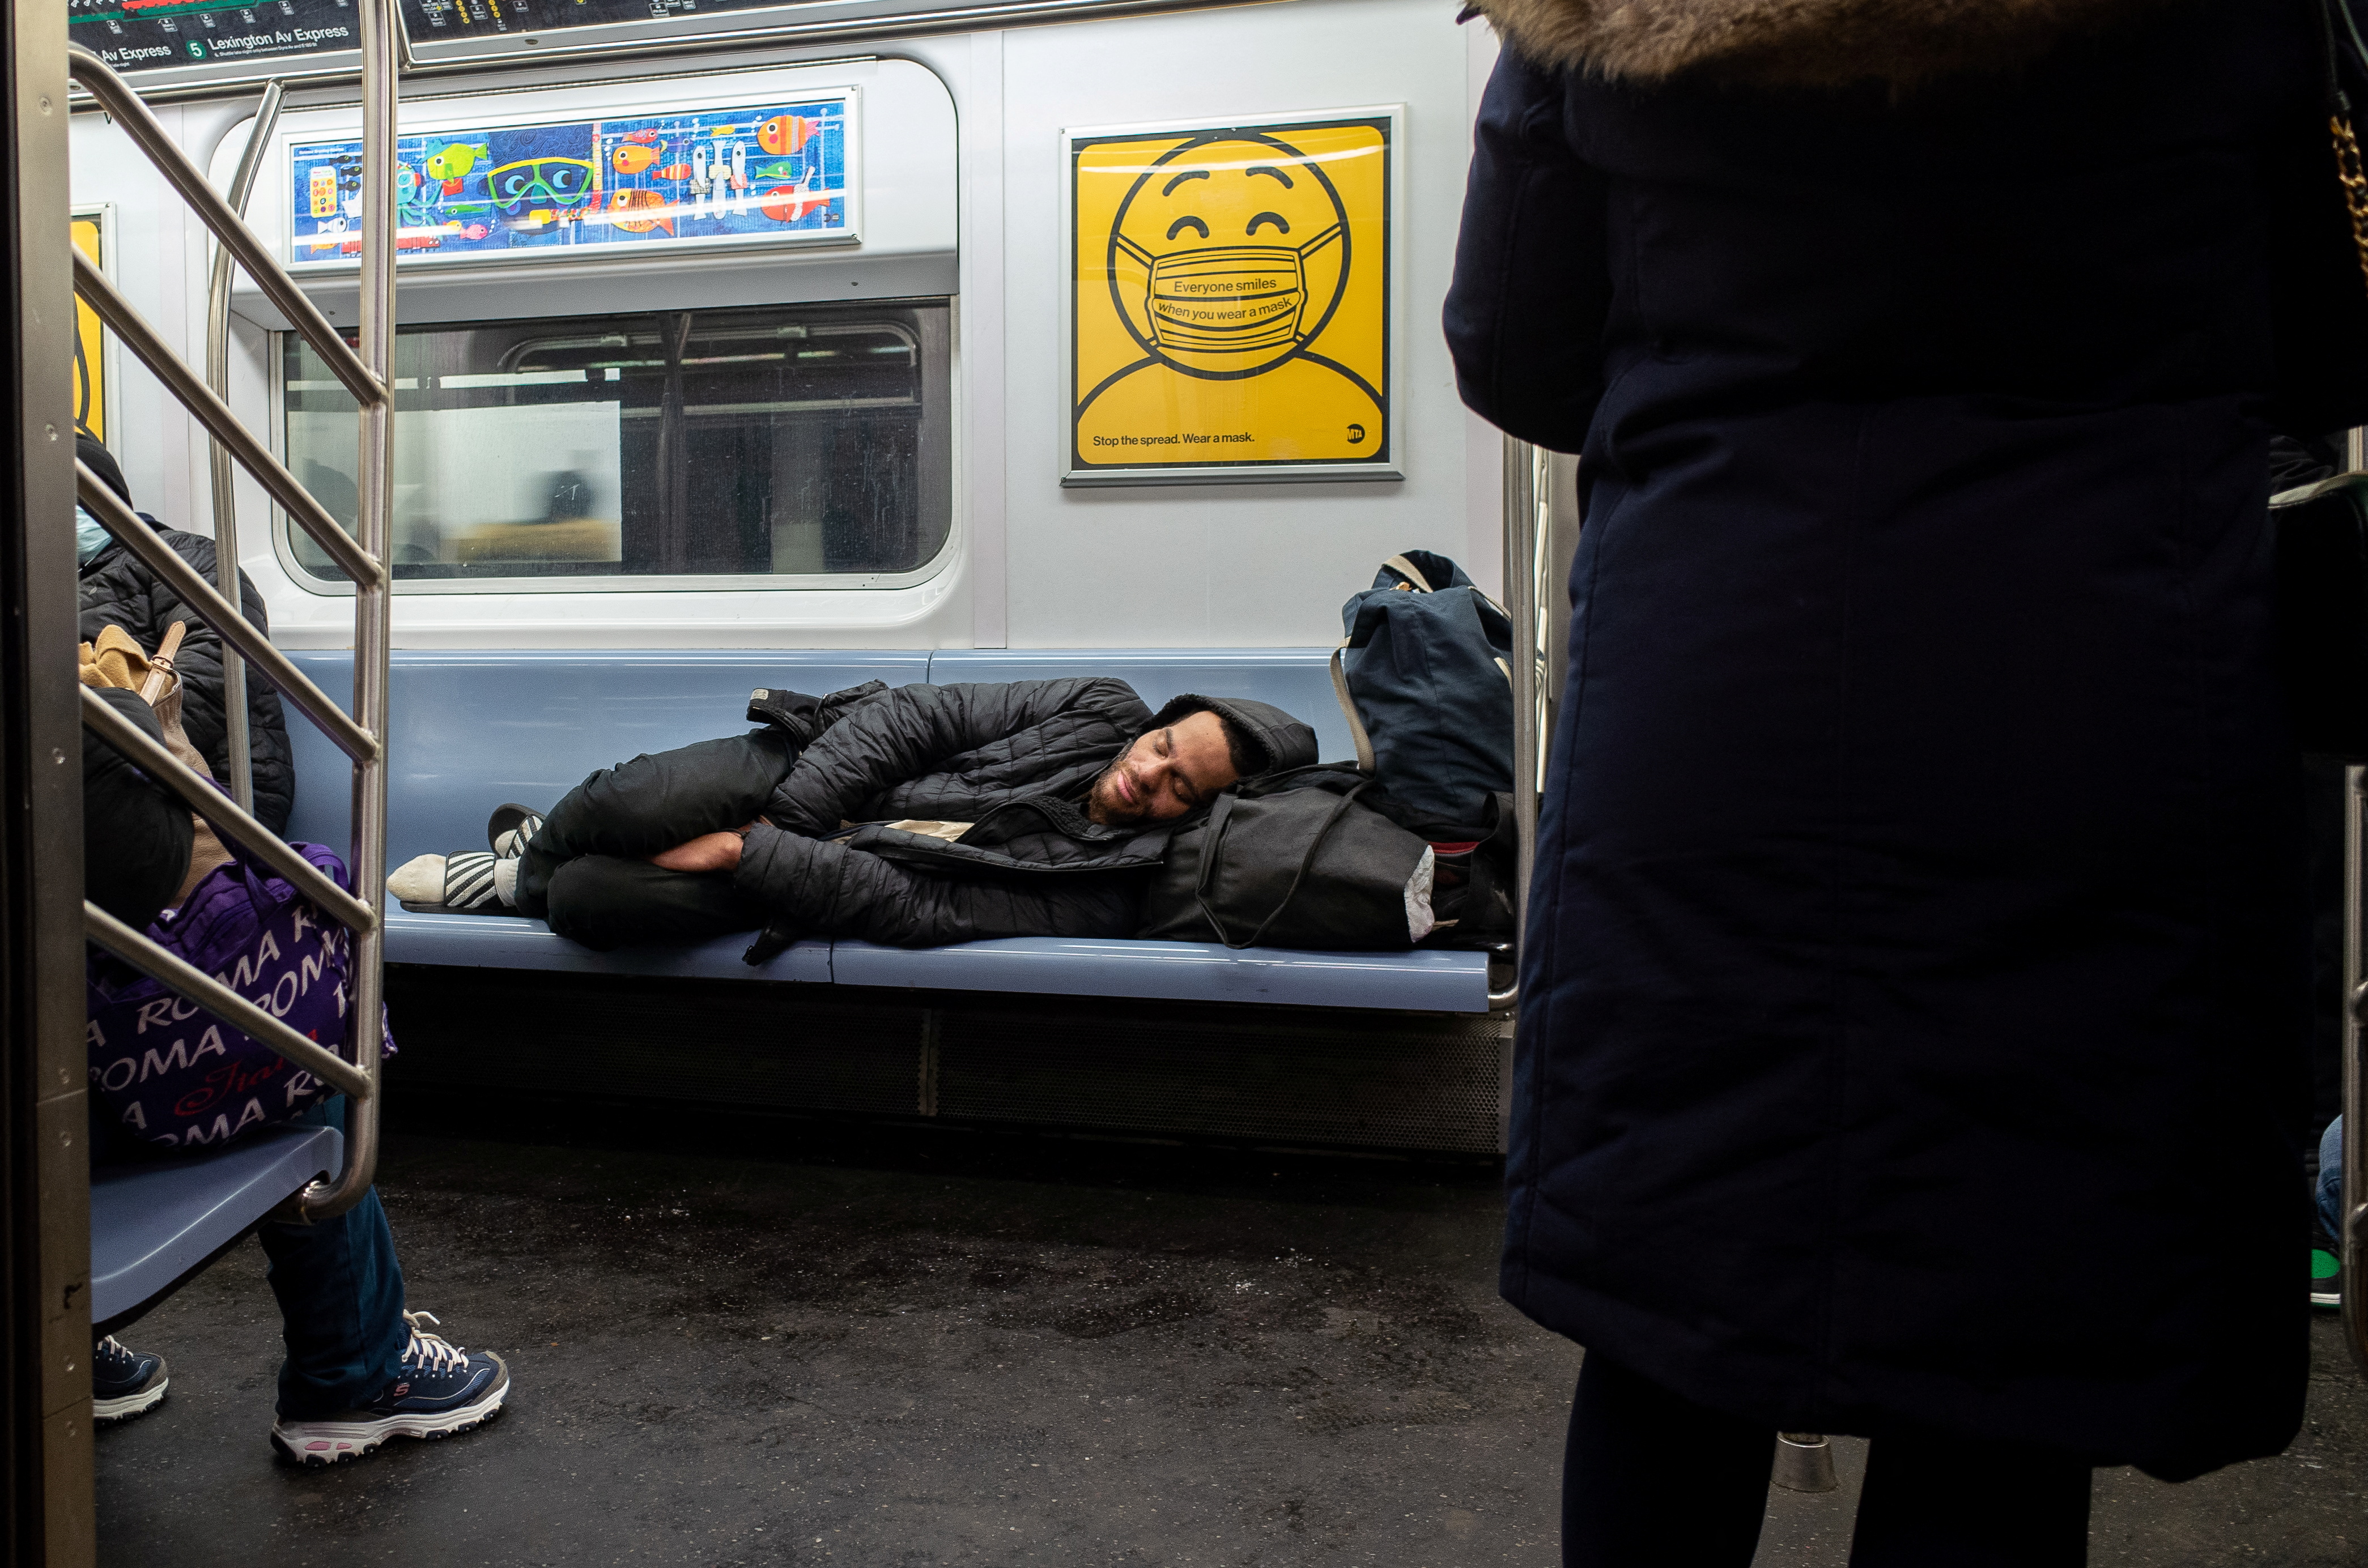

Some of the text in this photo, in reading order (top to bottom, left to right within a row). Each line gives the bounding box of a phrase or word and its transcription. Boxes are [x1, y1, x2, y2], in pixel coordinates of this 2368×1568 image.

[189, 42, 202, 57] 5
[207, 34, 273, 50] Lexington
[275, 31, 292, 44] Av
[293, 26, 349, 42] Express
[101, 45, 172, 62] Av Express
[1174, 278, 1277, 295] Everyone smiles
[1158, 297, 1293, 321] when you wear a mask
[1093, 435, 1119, 447] Stop
[1121, 435, 1138, 445] the
[1140, 434, 1180, 446] spread.
[1182, 433, 1211, 444] Wear
[1222, 432, 1255, 443] mask.
